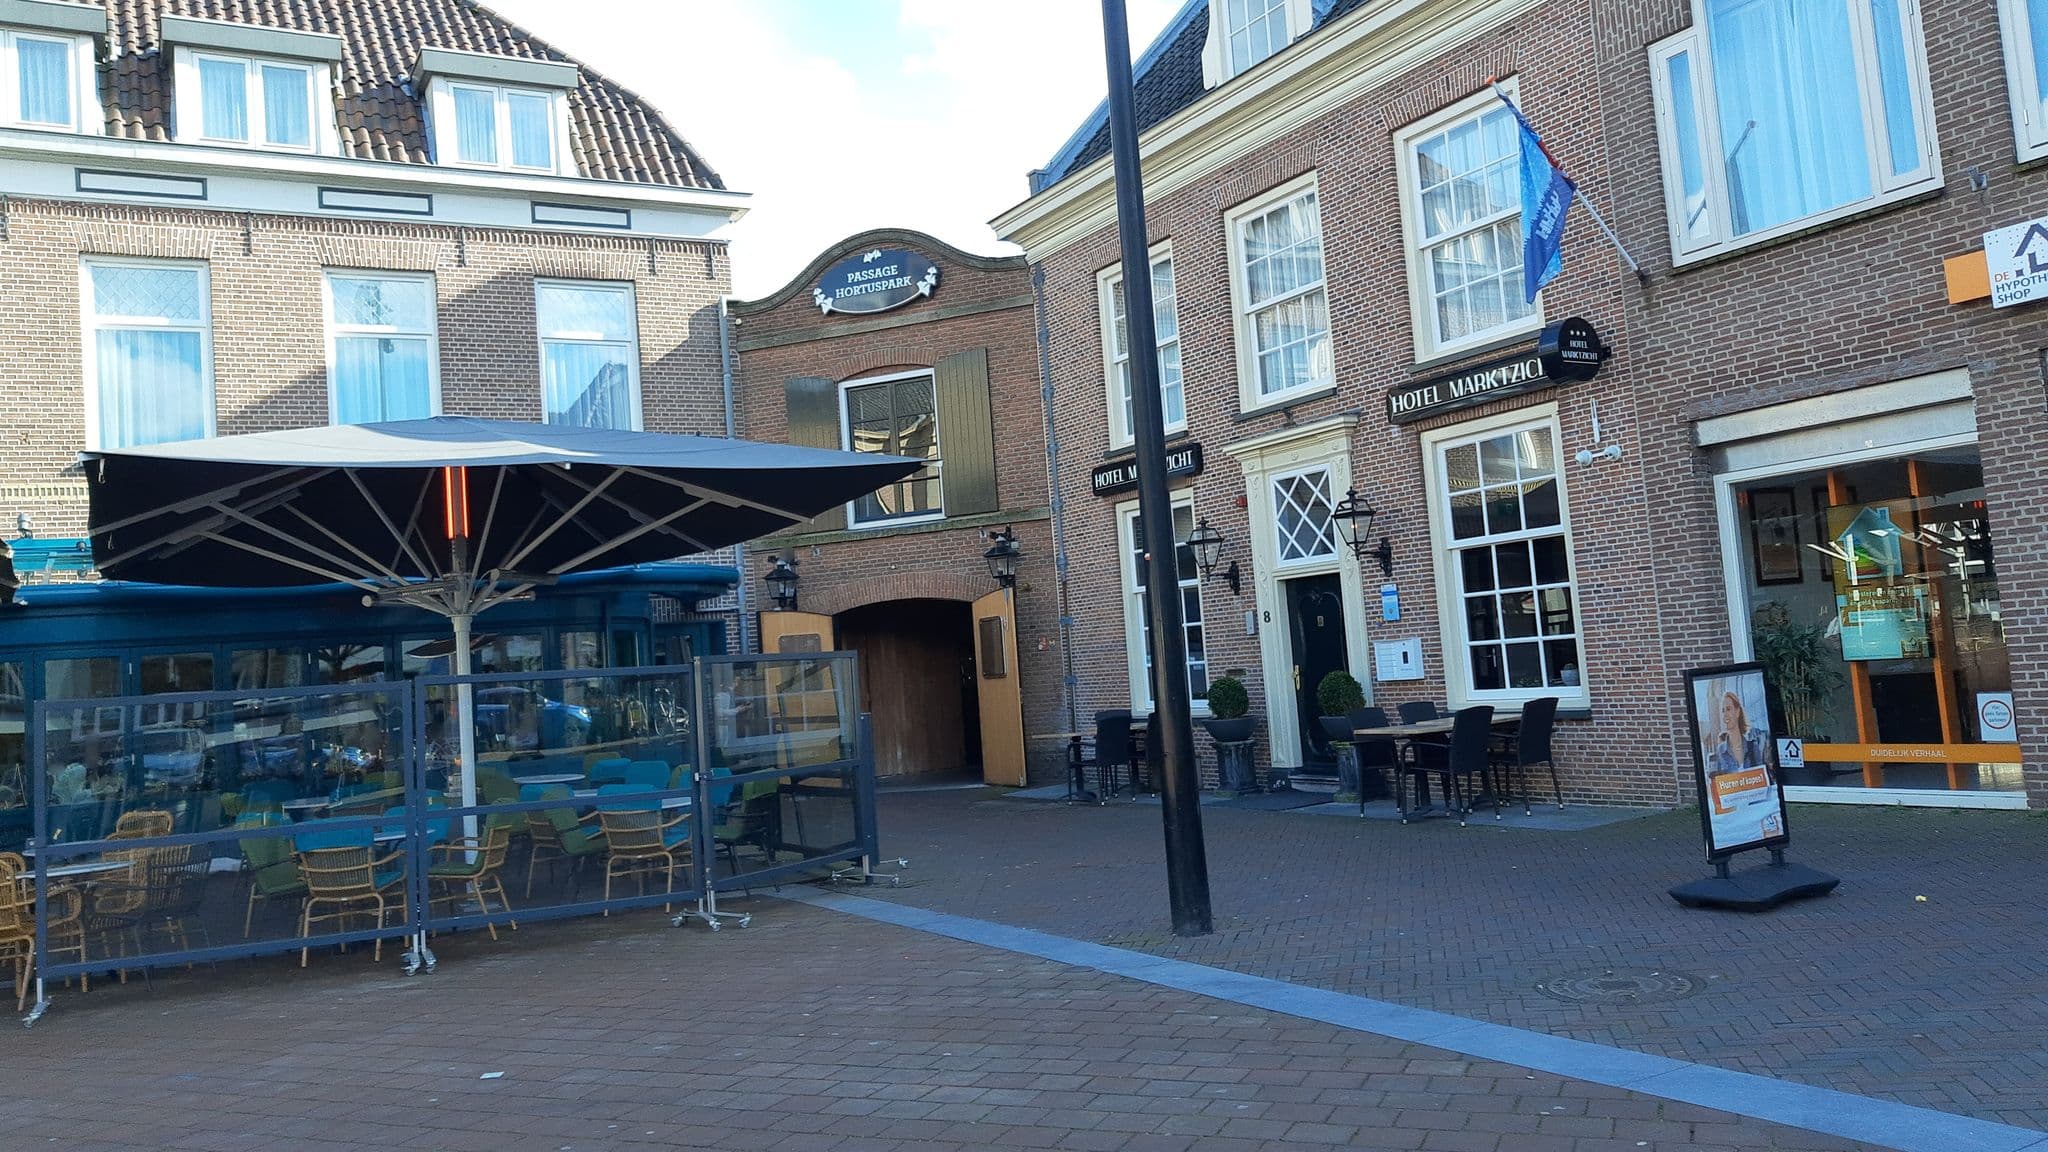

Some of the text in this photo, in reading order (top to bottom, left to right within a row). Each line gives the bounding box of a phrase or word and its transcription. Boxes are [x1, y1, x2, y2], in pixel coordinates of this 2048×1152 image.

[847, 265, 898, 283] PASSAGE
[1994, 271, 2009, 282] DE
[835, 276, 912, 299] HORTUSPARK
[1998, 288, 2031, 304] SHOP
[1569, 340, 1588, 349] HOTEL
[1392, 357, 1543, 413] HOTEL MARKTZIC
[1094, 468, 1125, 488] HOTEL
[1263, 611, 1271, 623] 8
[1910, 748, 1947, 758] VERHAAL
[1719, 779, 1738, 790] Huren
